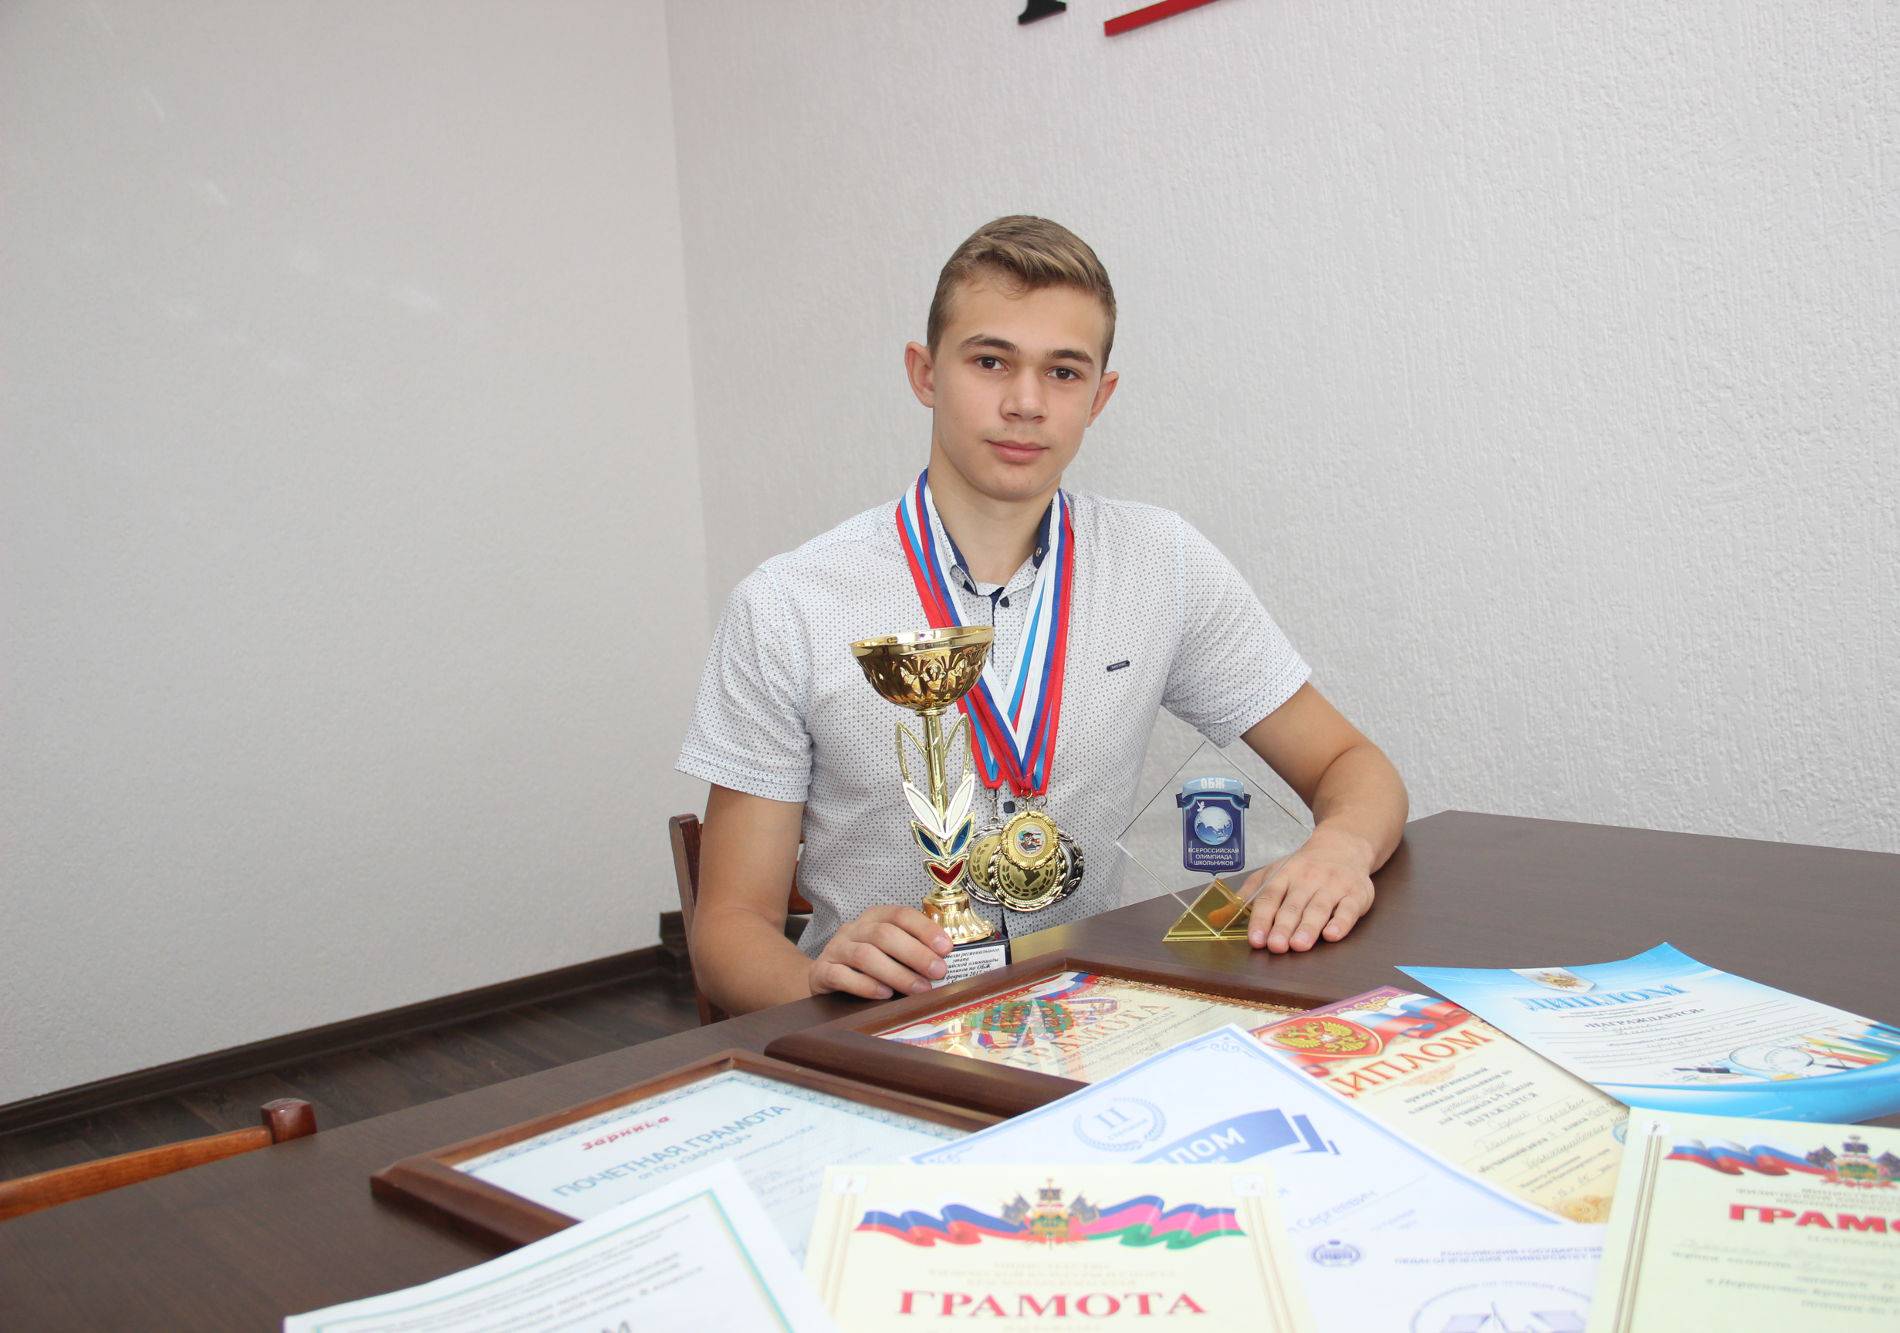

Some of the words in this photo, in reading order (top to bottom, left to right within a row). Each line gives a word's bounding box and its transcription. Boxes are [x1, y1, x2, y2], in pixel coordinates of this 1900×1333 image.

[1200, 778, 1225, 789] ОБЖ
[1513, 984, 1690, 1012] ДИПЛОМ
[552, 1143, 686, 1198] ПОЧЕТНАЯ
[683, 1104, 791, 1150] ГРАМОТА
[1728, 1203, 1900, 1234] ГРАМ
[896, 1289, 1207, 1318] ГРАМОТА
